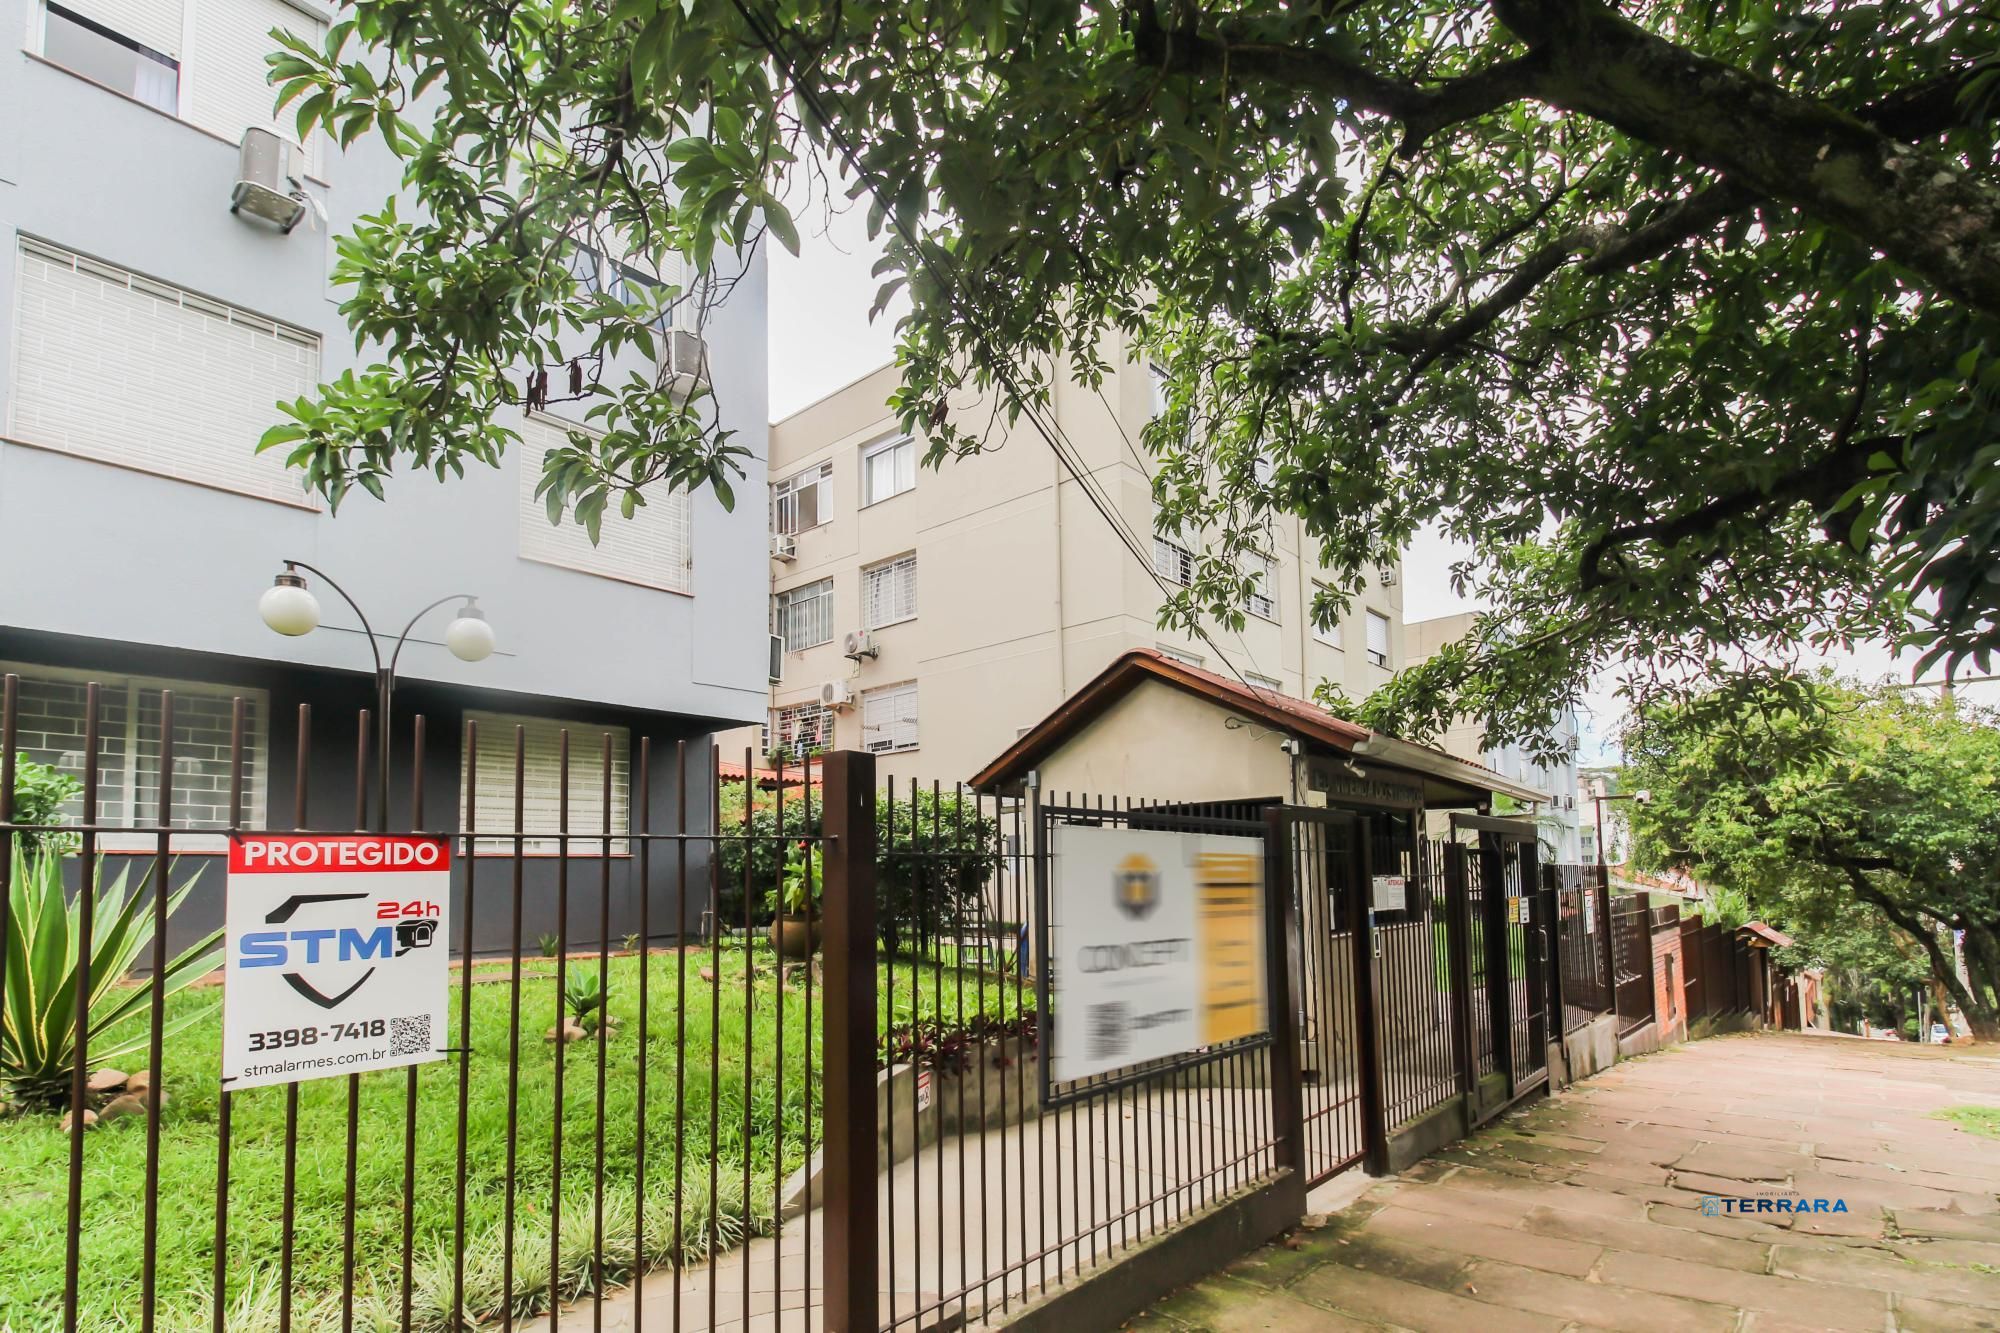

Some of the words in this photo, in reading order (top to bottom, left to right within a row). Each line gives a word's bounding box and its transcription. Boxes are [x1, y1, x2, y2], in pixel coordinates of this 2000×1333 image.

[244, 841, 439, 867] PROTEGIDO
[376, 900, 440, 919] 24h
[239, 926, 393, 969] STM
[248, 1019, 386, 1052] 3398-7418
[244, 1048, 387, 1078] stmalarmes.com.br
